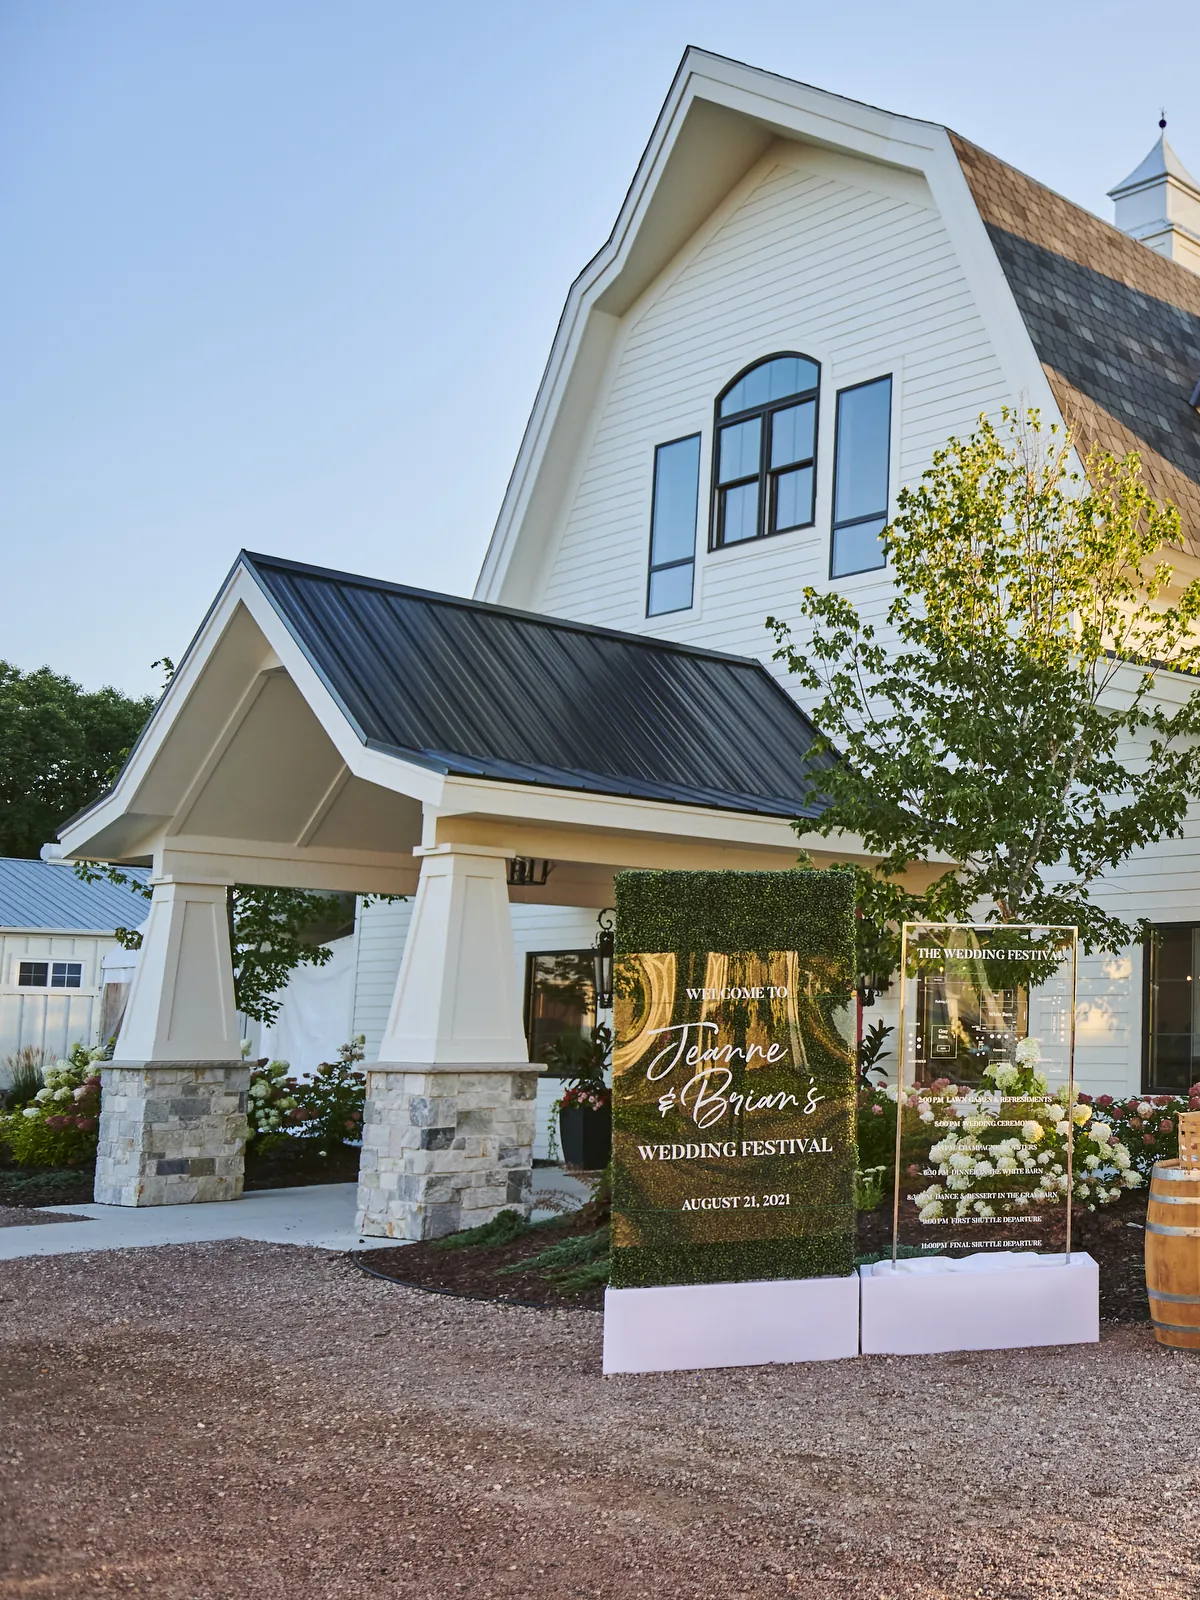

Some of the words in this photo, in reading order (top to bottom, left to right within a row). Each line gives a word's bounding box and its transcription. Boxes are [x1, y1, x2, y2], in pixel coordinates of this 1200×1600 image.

[917, 948, 941, 958] THE
[943, 948, 1005, 960] WEDDING
[1007, 949, 1066, 961] FESTIVAL
[685, 987, 765, 1000] WELCOME
[767, 986, 788, 999] TO
[646, 1022, 788, 1081] Jeanne
[658, 1088, 676, 1119] &
[680, 1067, 825, 1129] Brian's
[637, 1142, 738, 1162] WEDDING
[740, 1137, 833, 1158] FESTIVAL
[681, 1196, 741, 1211] AUGUST
[742, 1195, 760, 1209] 21,
[761, 1193, 791, 1208] 2021
